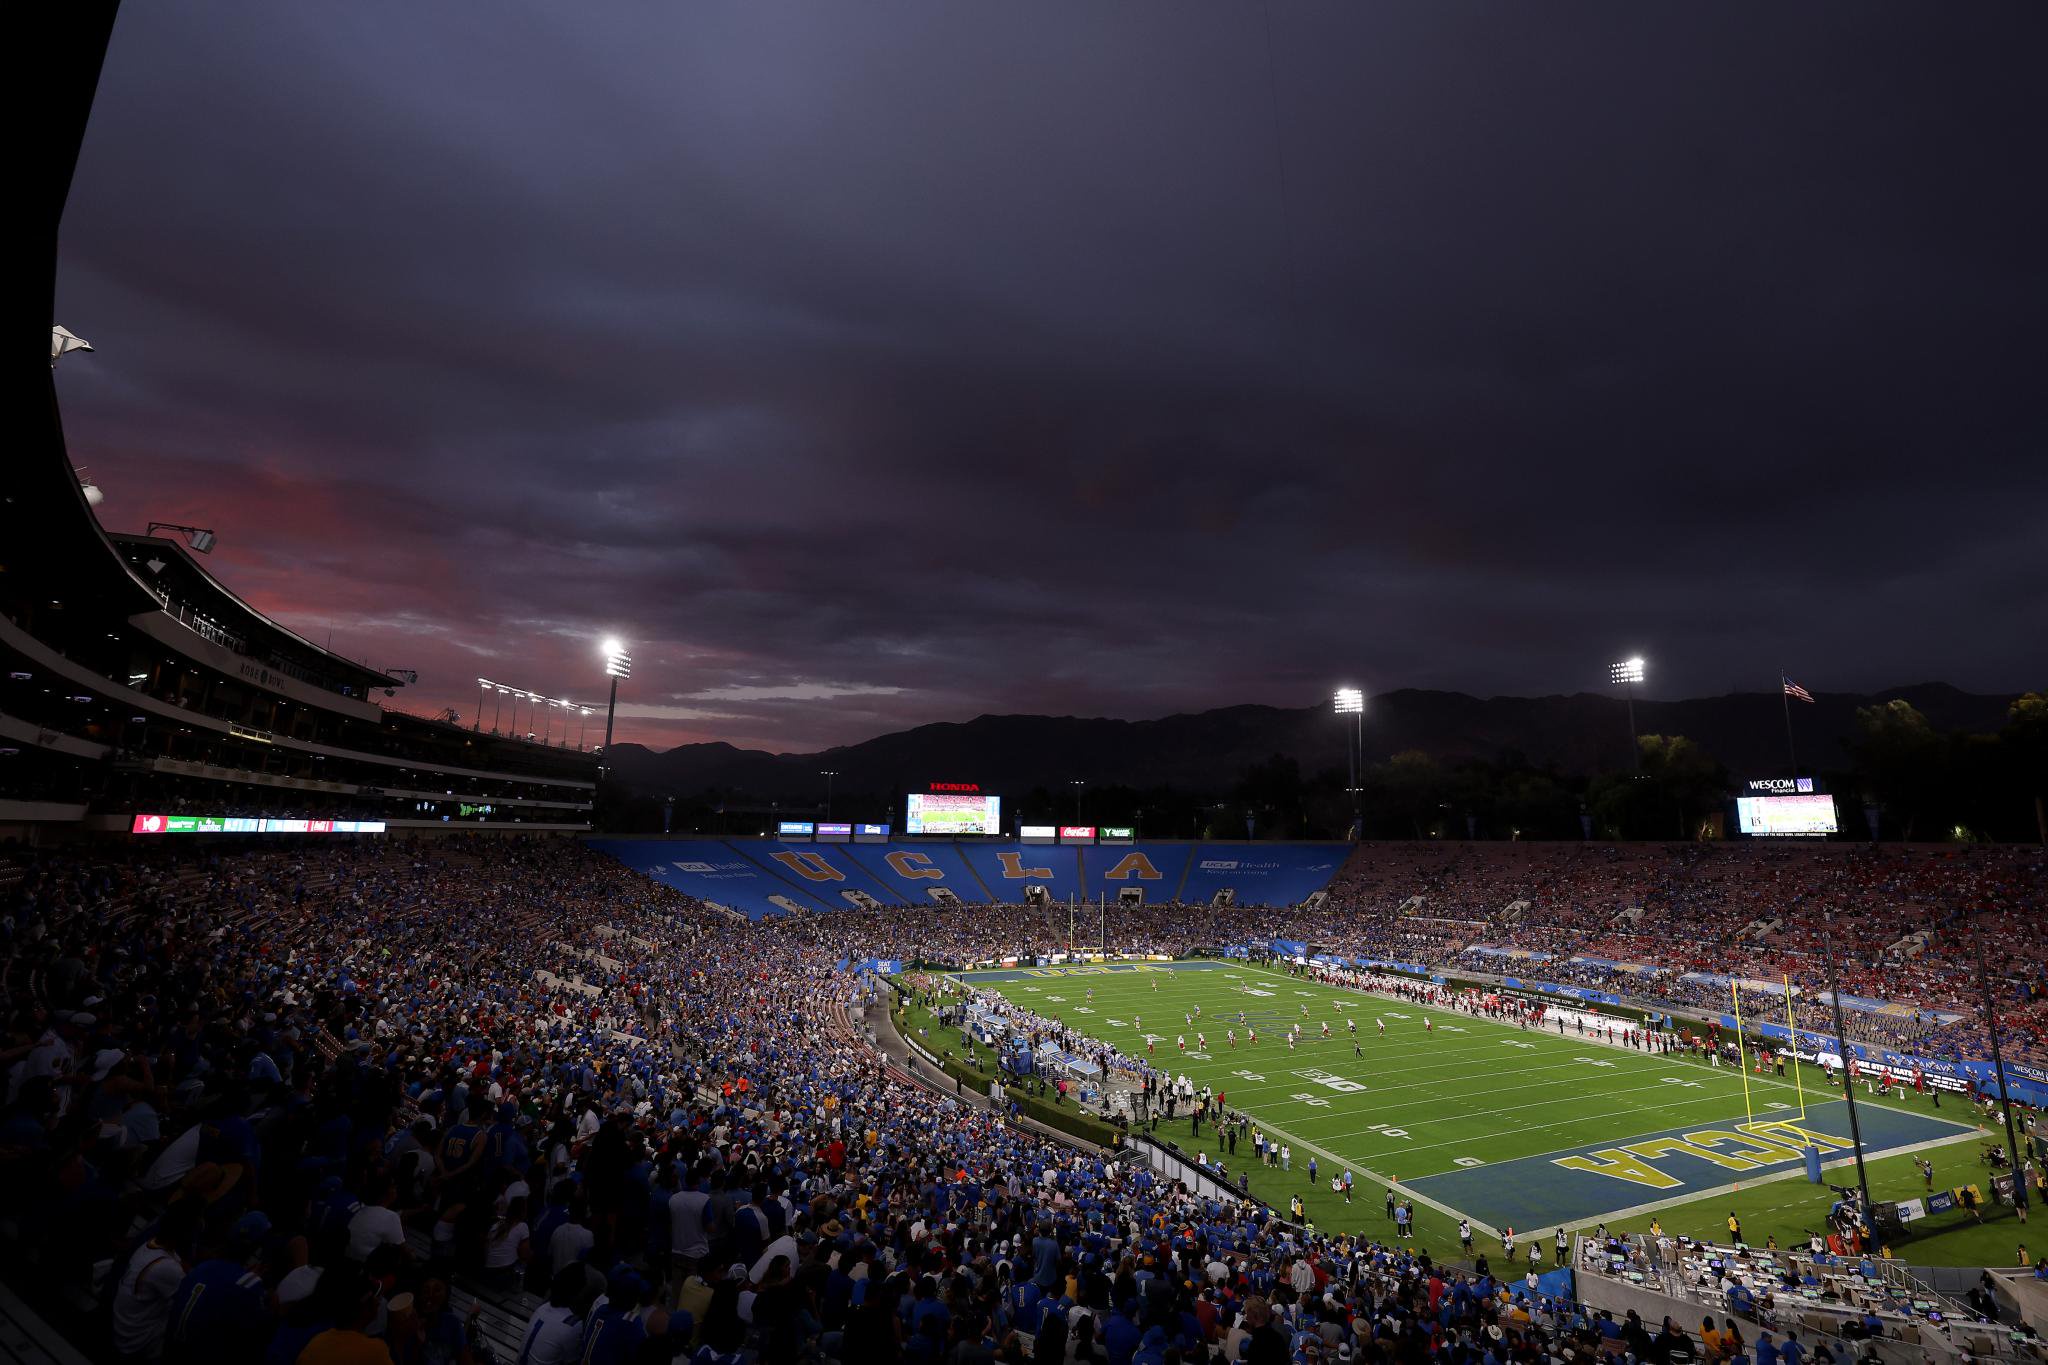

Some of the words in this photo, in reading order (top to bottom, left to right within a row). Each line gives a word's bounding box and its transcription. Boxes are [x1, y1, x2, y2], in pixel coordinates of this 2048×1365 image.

[930, 783, 980, 791] HONDA
[1749, 780, 1795, 790] WESCOM
[1232, 1069, 1263, 1081] 30
[2013, 1064, 2045, 1078] WESCOM
[1290, 1093, 1328, 1106] 20
[1368, 1124, 1408, 1137] 10
[1550, 1121, 1867, 1189] UCLA
[1453, 1157, 1485, 1167] G
[1018, 1287, 1026, 1308] 1
